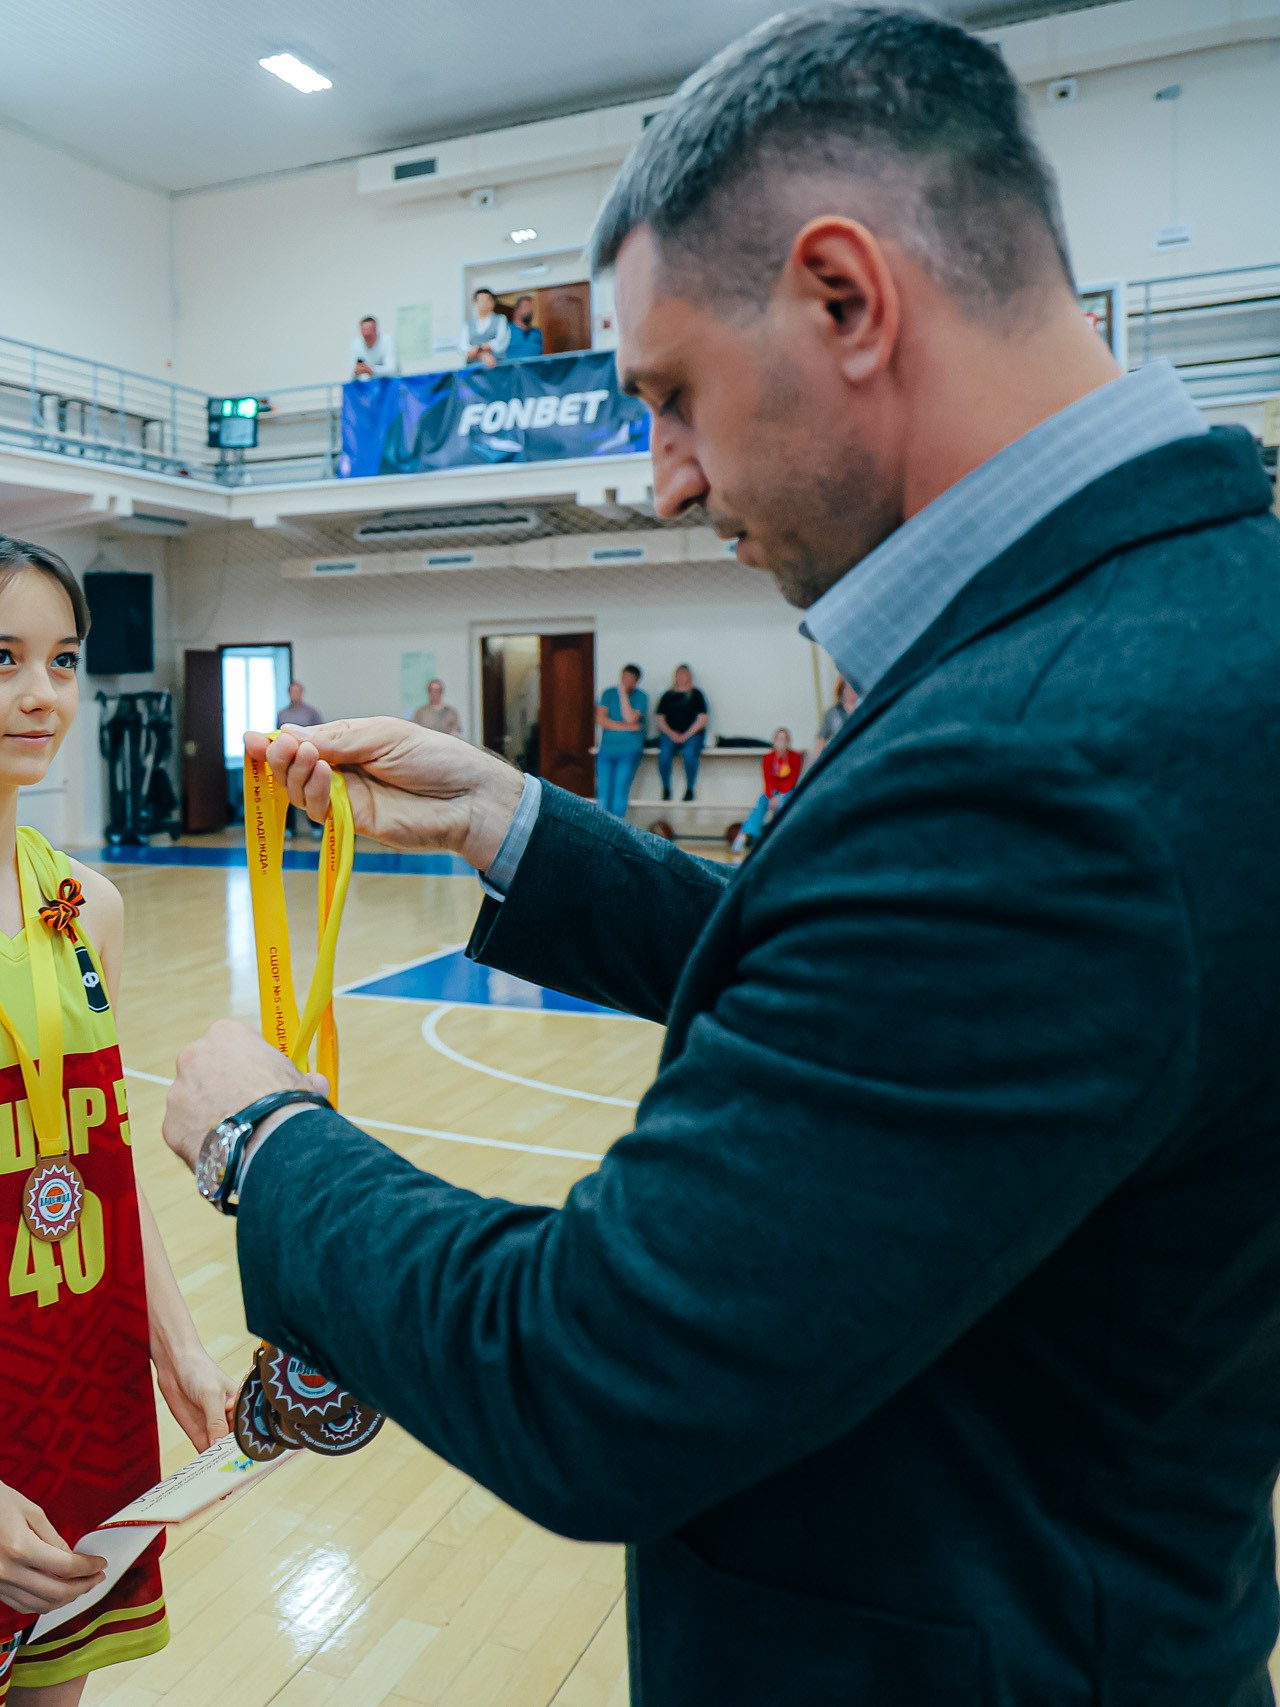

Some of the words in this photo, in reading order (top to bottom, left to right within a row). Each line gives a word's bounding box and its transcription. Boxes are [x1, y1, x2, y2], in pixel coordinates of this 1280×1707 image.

[458, 389, 610, 437] FONBET
[251, 757, 260, 783] ШОР
[256, 805, 269, 876] «НАДЕЖДА»
[270, 946, 280, 982] СШОР
[273, 984, 282, 1003] №5
[276, 1005, 289, 1058] «НАДЕЖ
[8, 1188, 106, 1308] 40
